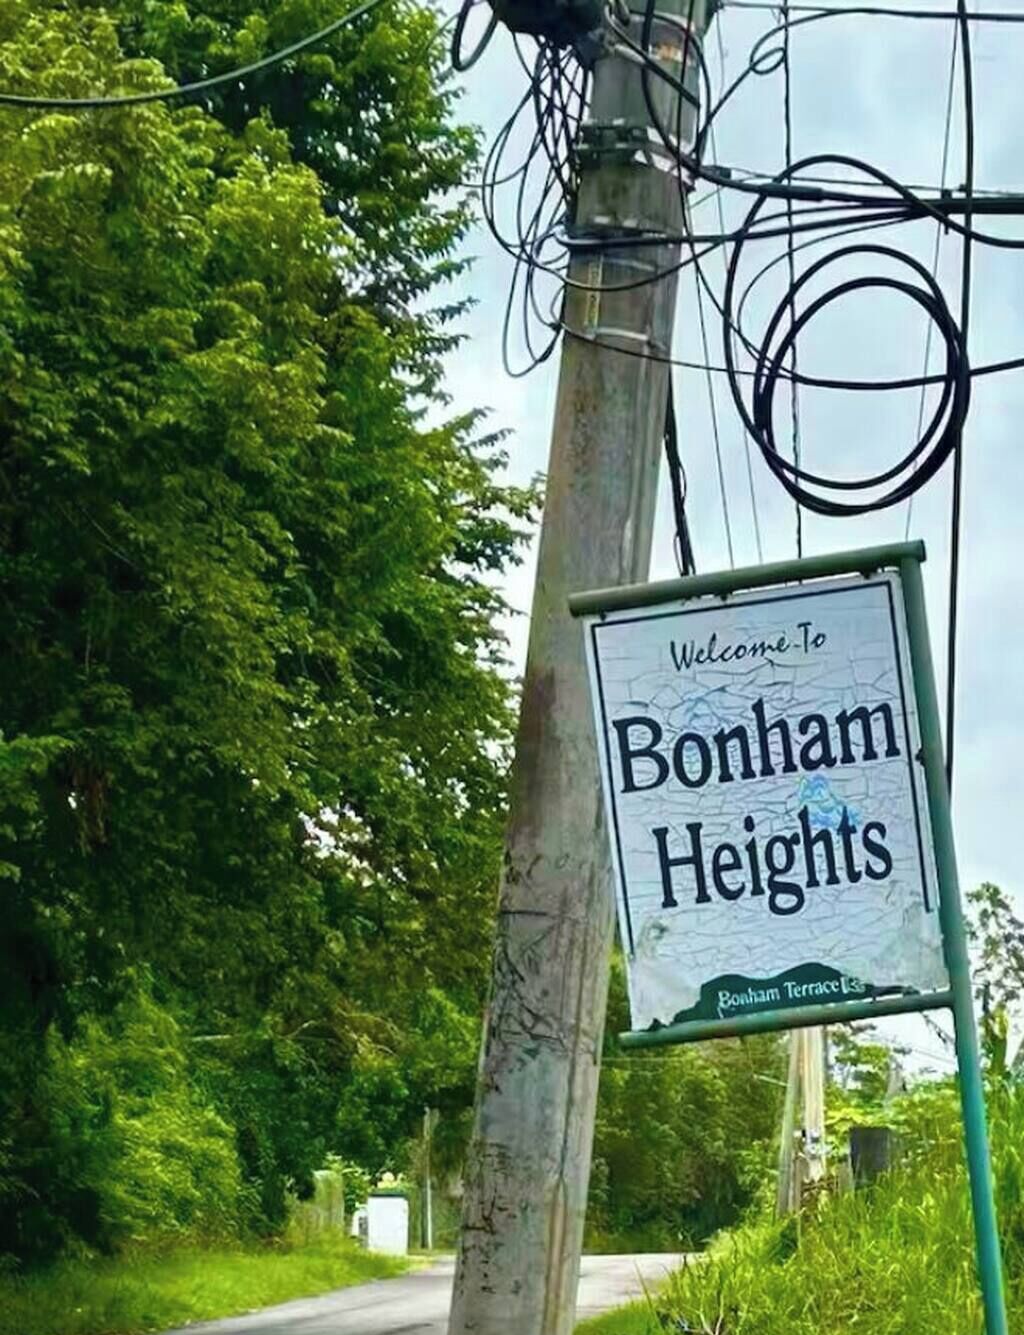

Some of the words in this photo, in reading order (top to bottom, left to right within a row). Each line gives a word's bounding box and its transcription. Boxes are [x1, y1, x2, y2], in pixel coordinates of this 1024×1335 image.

[670, 632, 790, 672] Welcome
[797, 621, 827, 654] To
[612, 699, 900, 793] Bonham
[652, 805, 893, 915] Heights
[717, 985, 780, 1008] Bonham
[783, 979, 841, 999] Terrace
